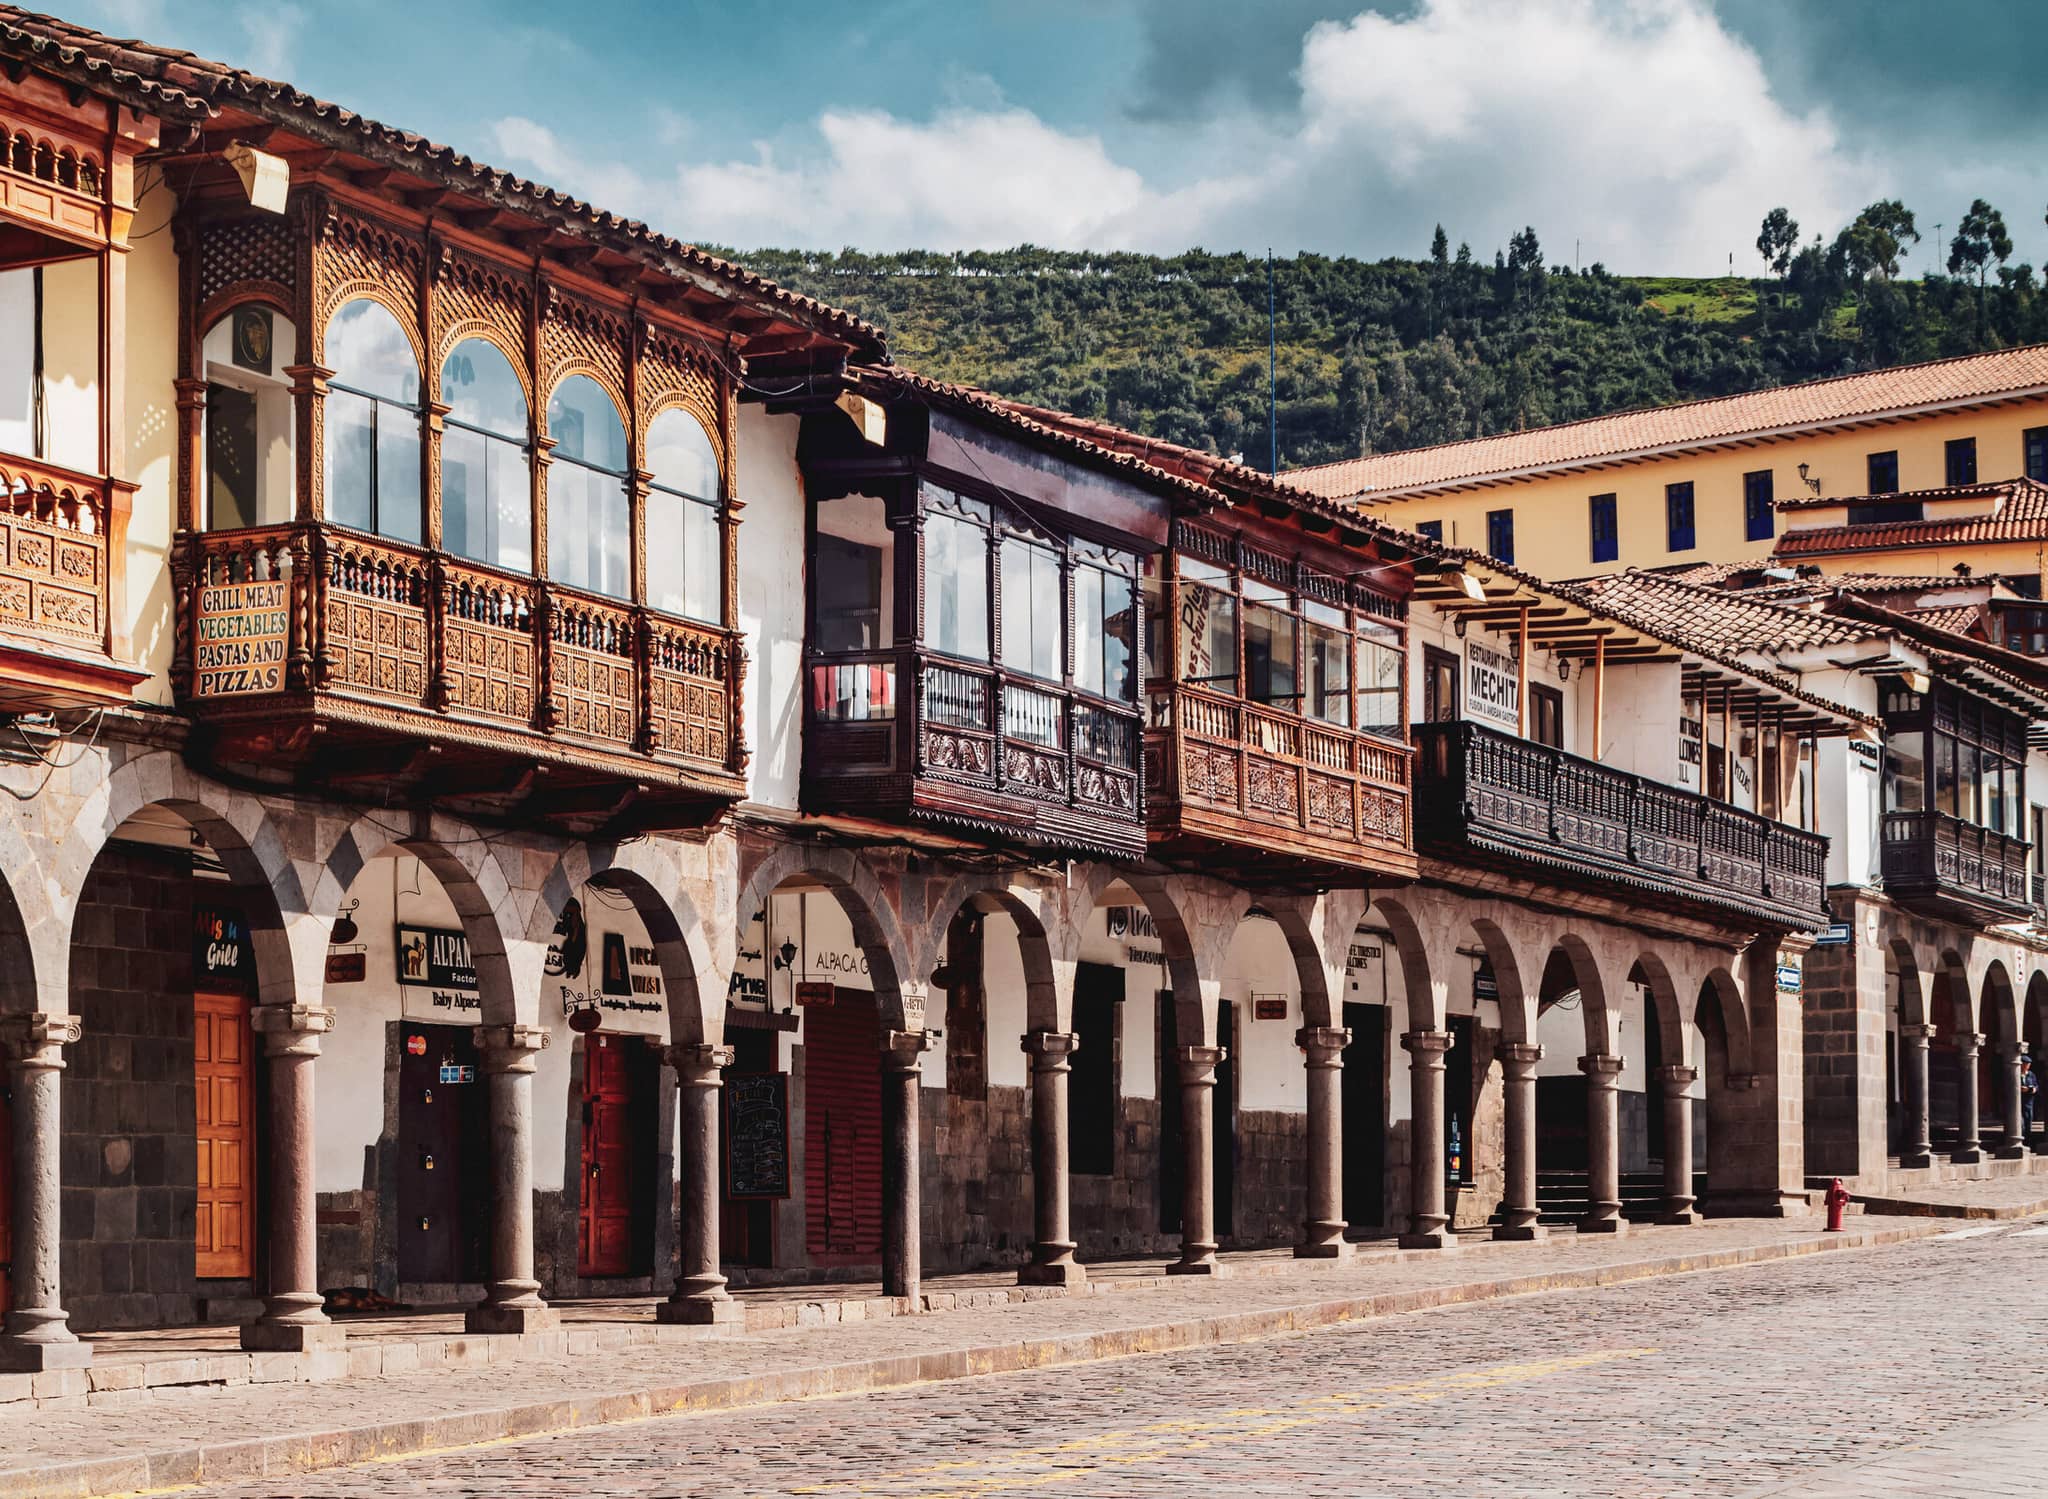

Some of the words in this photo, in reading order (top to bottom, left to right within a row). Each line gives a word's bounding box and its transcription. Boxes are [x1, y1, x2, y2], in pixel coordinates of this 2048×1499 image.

[203, 588, 242, 612] GRILL
[245, 584, 285, 609] MEAT
[199, 612, 287, 640] VEGETABLES
[198, 643, 250, 667] PASTAS
[253, 640, 284, 663] AND
[1470, 642, 1500, 670] RESTAURANT
[200, 668, 279, 695] PIZZAS
[207, 942, 238, 970] Grill
[433, 935, 475, 968] ALPAN
[816, 952, 857, 973] ALPACA
[452, 973, 477, 984] Factor
[432, 990, 452, 1010] Baby
